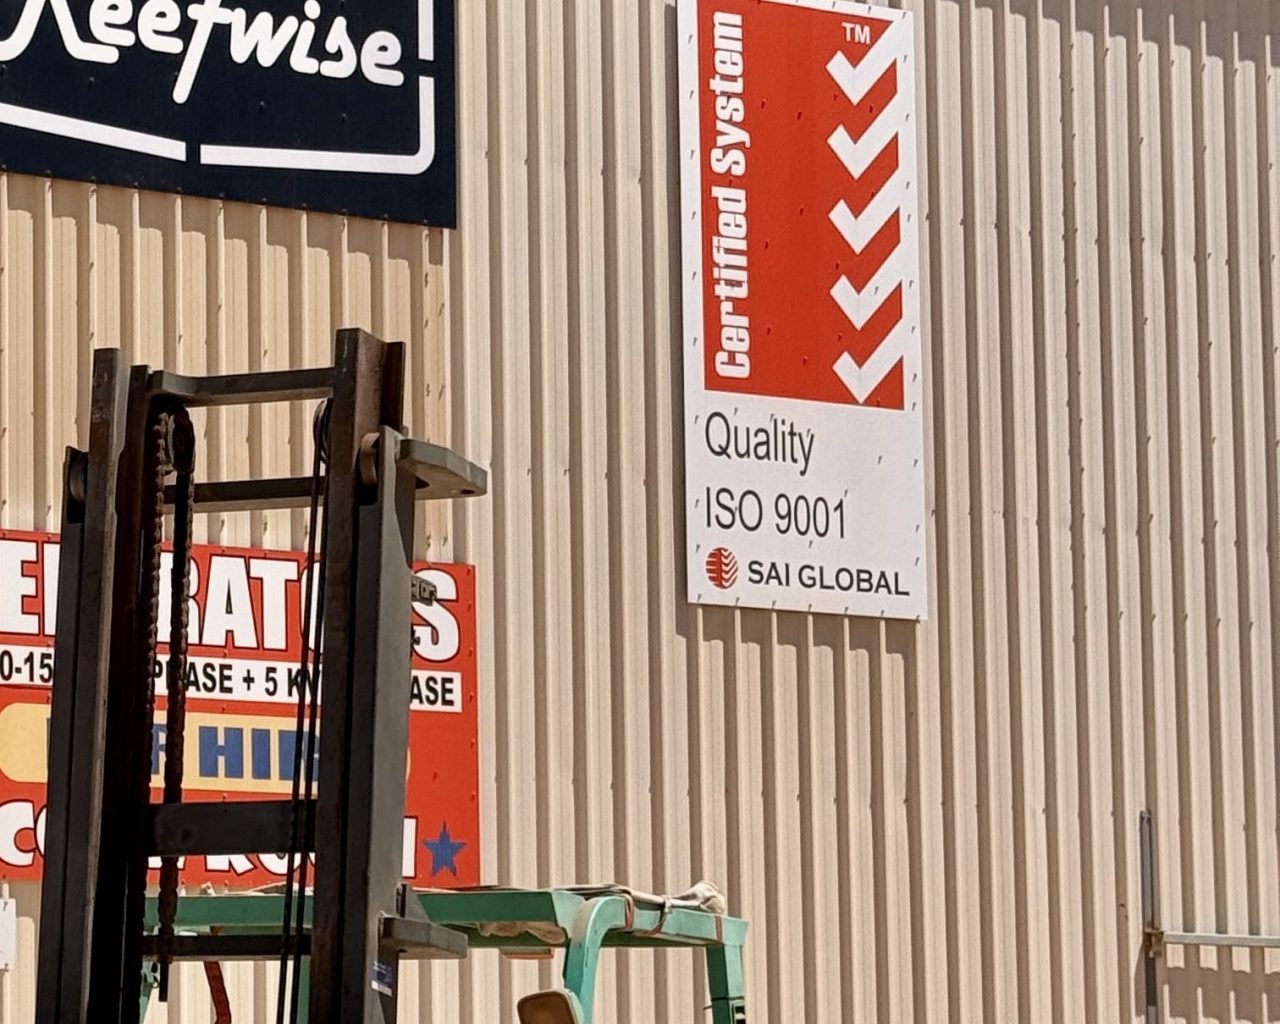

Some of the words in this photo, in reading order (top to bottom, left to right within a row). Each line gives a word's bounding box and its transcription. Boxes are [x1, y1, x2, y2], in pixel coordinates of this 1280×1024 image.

[841, 22, 871, 45] TM
[709, 11, 751, 177] System
[711, 186, 751, 379] Certified
[705, 411, 815, 476] Quality
[705, 486, 763, 532] ISO
[774, 491, 845, 539] 9001
[747, 560, 791, 588] SAI
[798, 564, 911, 597] GLOBAL
[264, 666, 278, 697] 5
[410, 675, 455, 707] ASE
